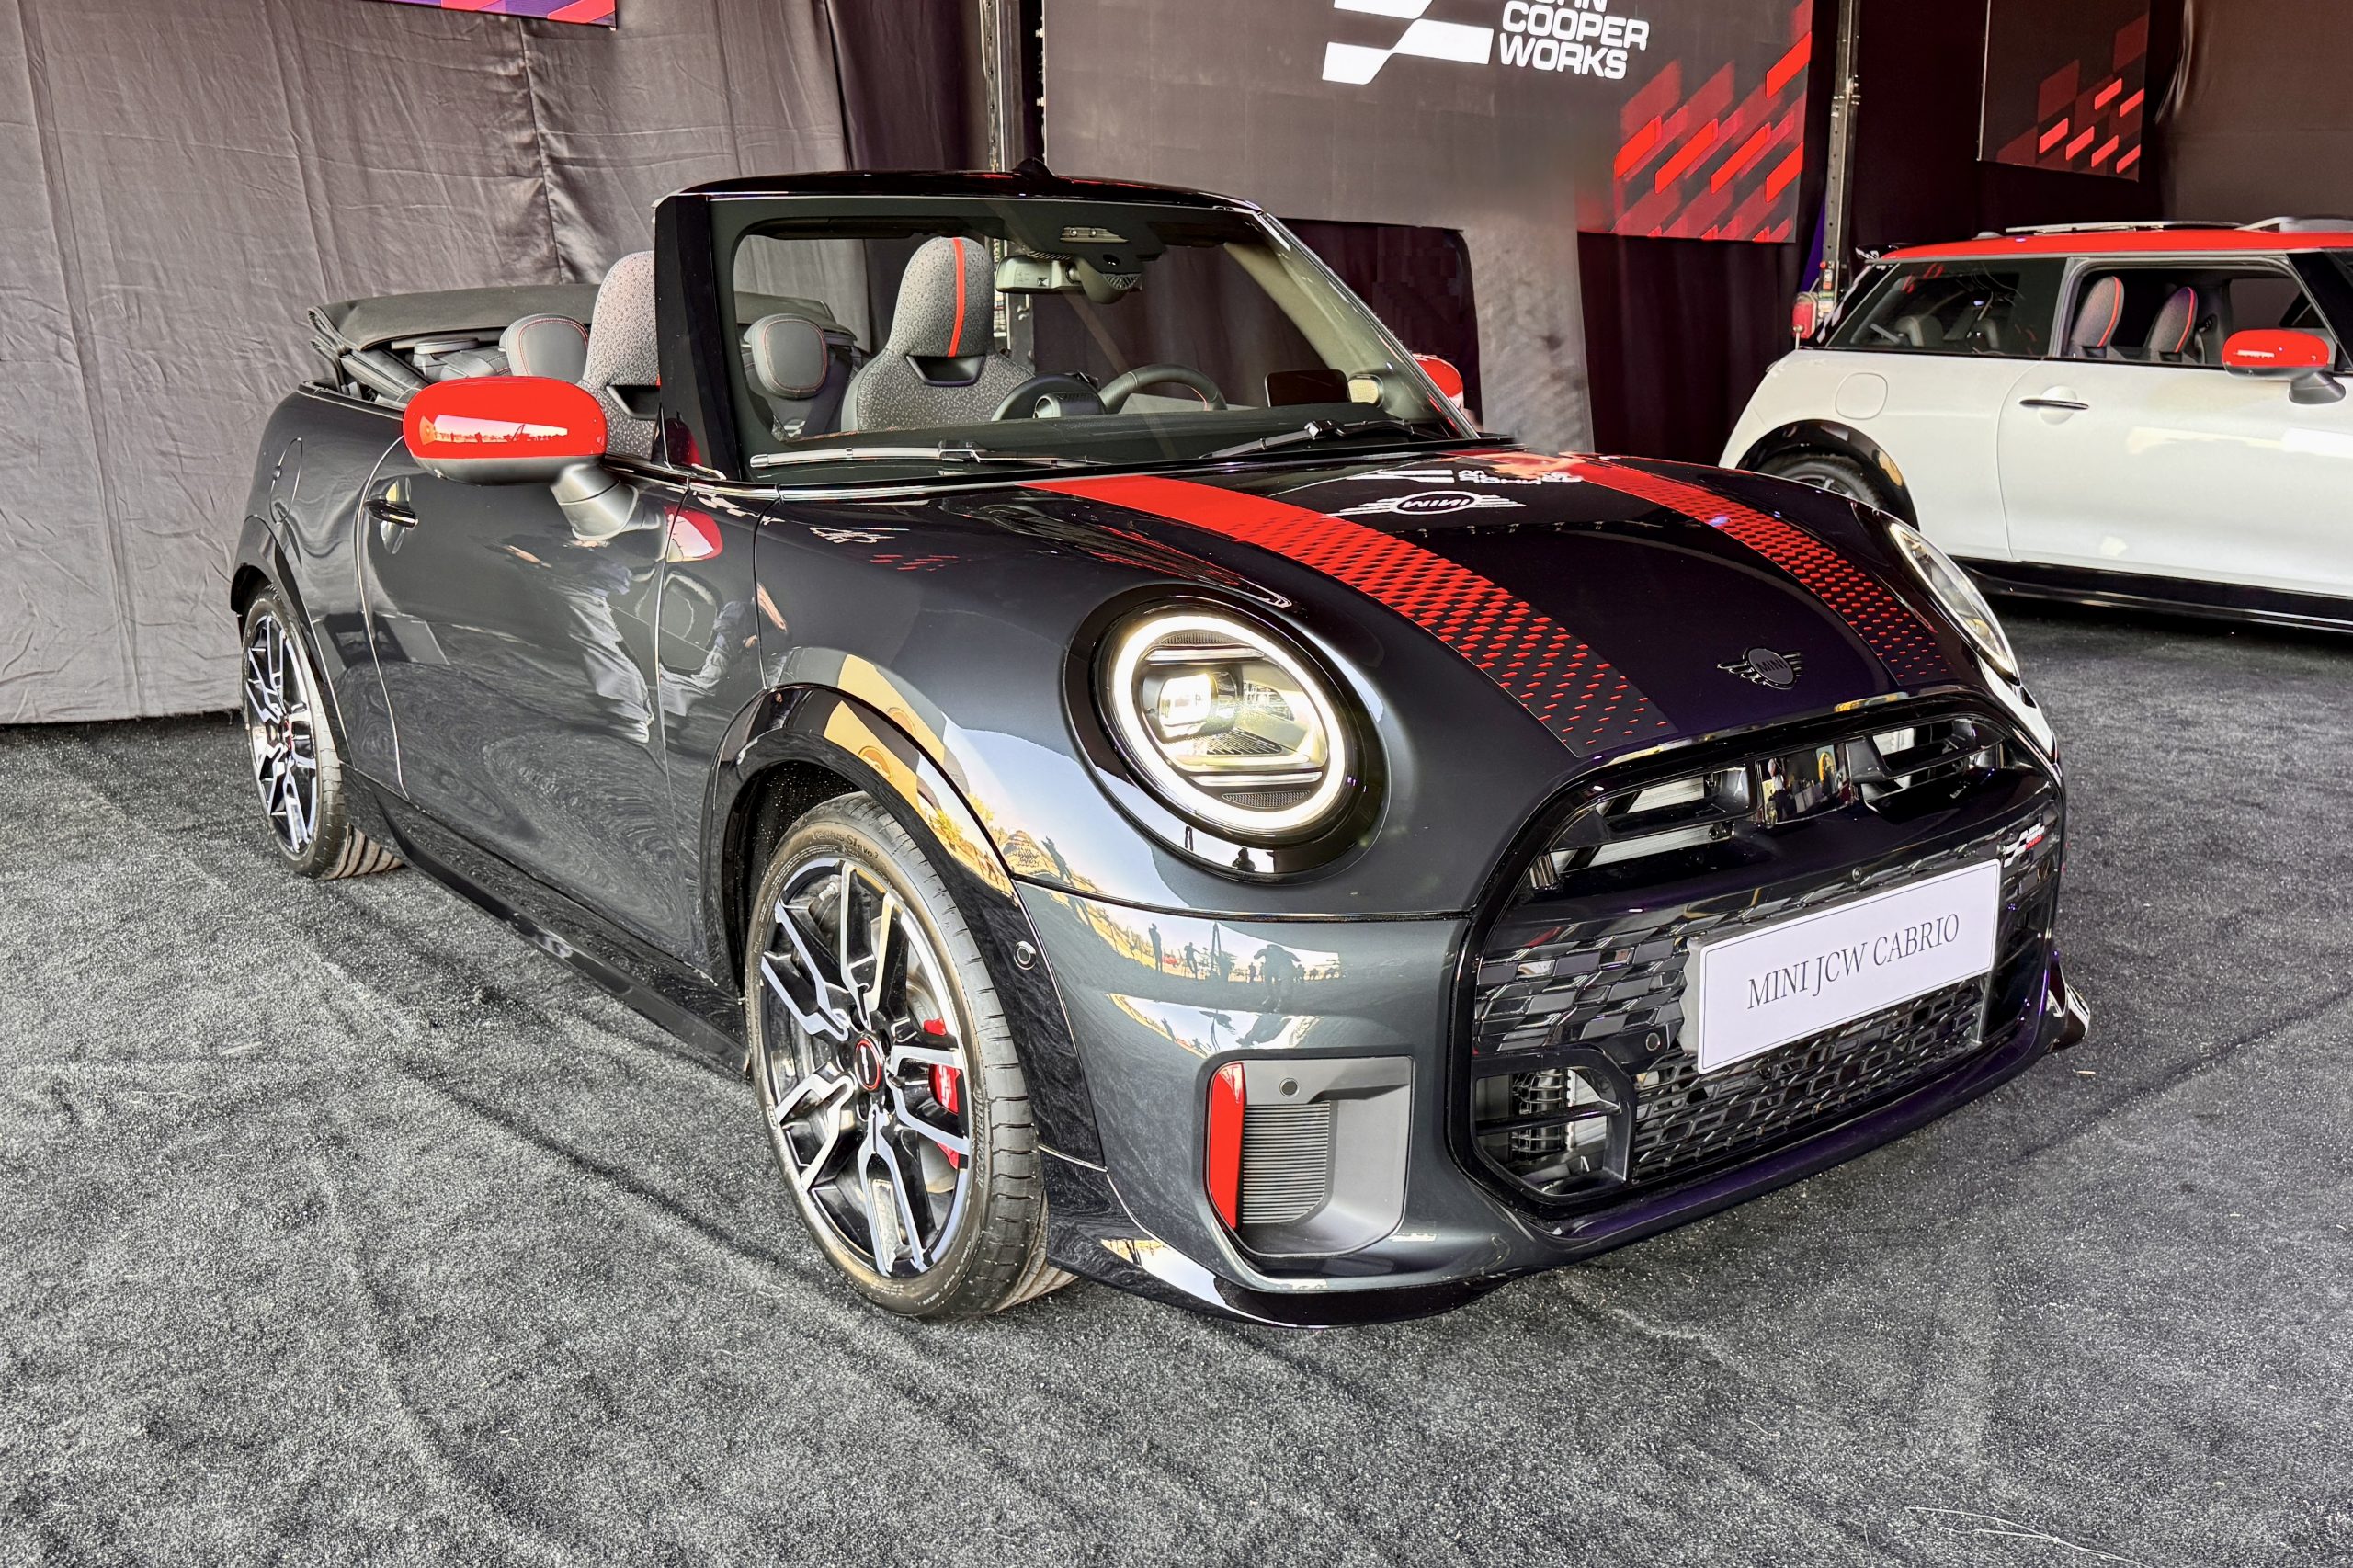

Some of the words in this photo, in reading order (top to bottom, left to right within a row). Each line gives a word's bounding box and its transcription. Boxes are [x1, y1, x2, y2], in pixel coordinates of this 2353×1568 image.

[1503, 0, 1650, 51] COOPER
[1500, 32, 1628, 80] WORKS
[1756, 658, 1788, 673] MINI
[1747, 960, 1808, 1010] MINI
[1812, 942, 1867, 997] JCW
[1873, 913, 1960, 967] CABRIO
